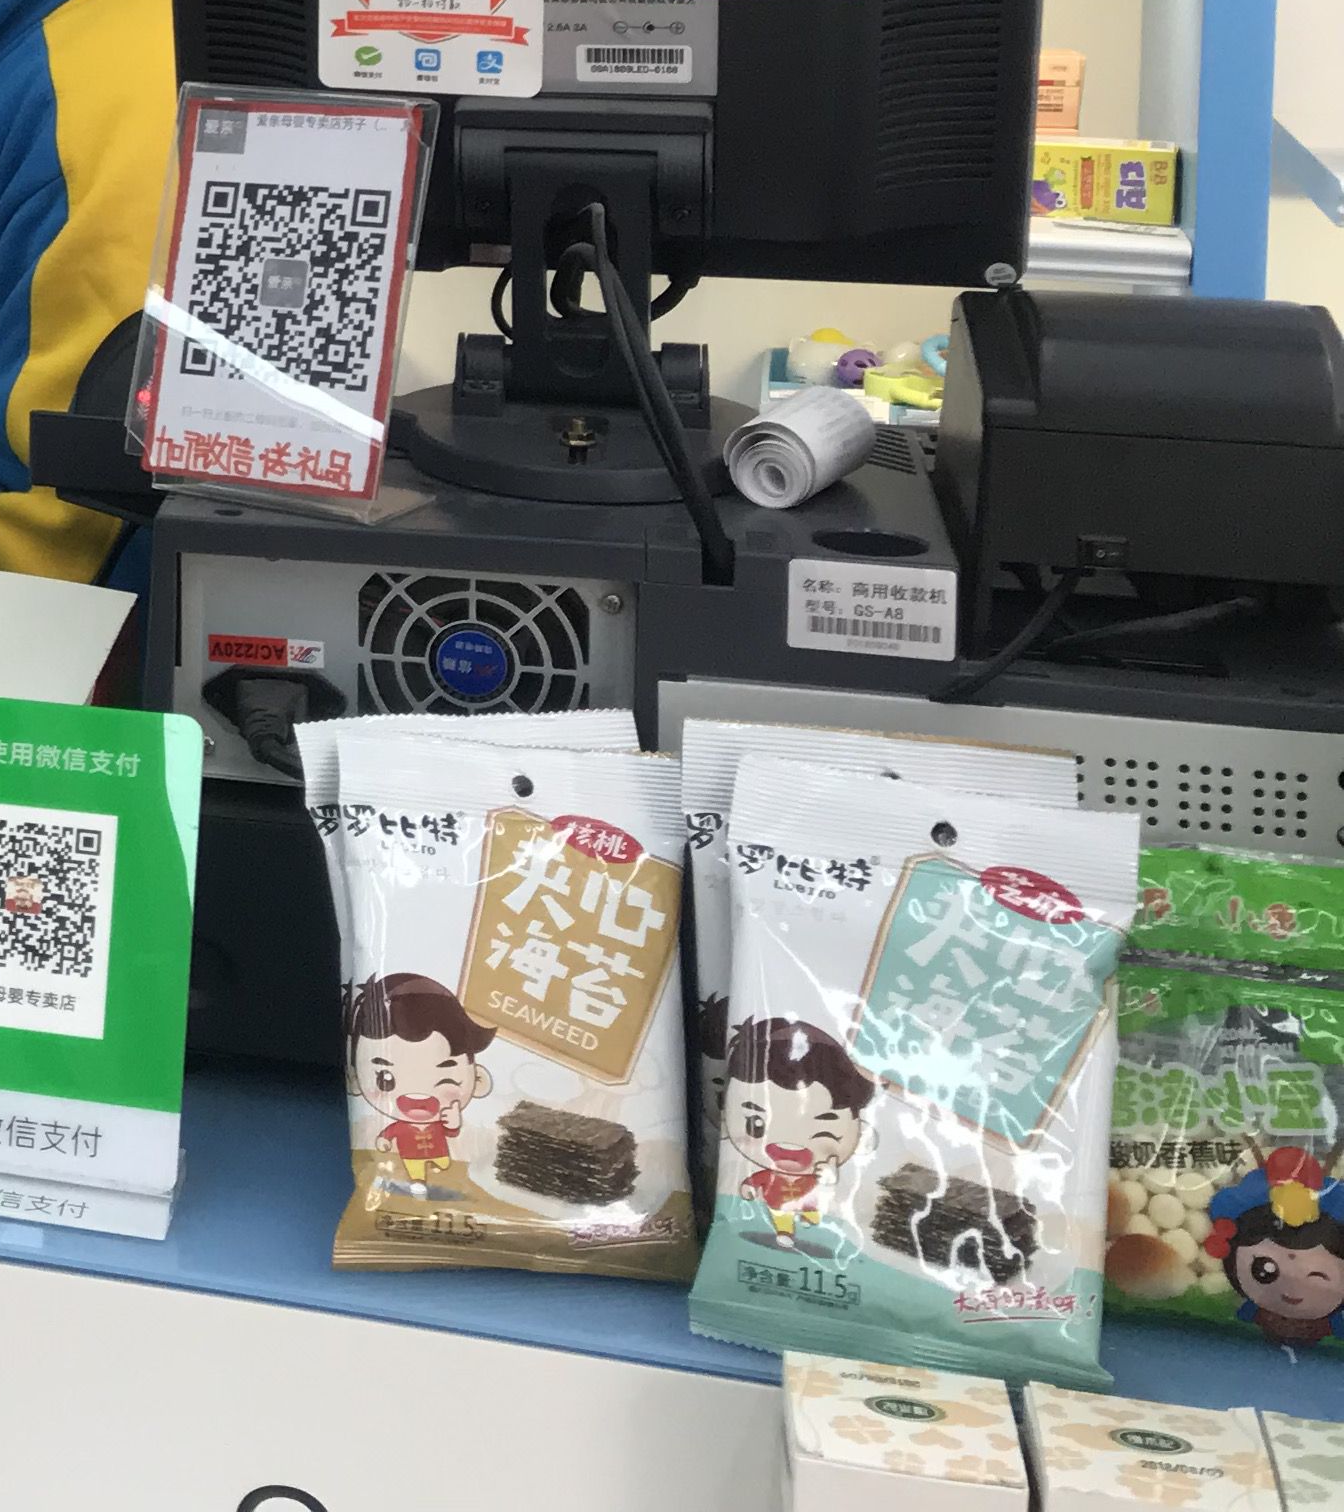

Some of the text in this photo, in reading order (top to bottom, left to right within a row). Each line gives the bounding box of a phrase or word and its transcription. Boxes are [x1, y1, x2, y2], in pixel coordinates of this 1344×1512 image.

[851, 580, 948, 606] 商用收款机
[853, 603, 905, 621] GS-A8
[210, 639, 286, 663] AC/220V
[567, 820, 629, 860] 核桃
[499, 836, 666, 950] 夹心
[485, 919, 646, 1029] 海苔
[486, 988, 600, 1055] SEAWEED
